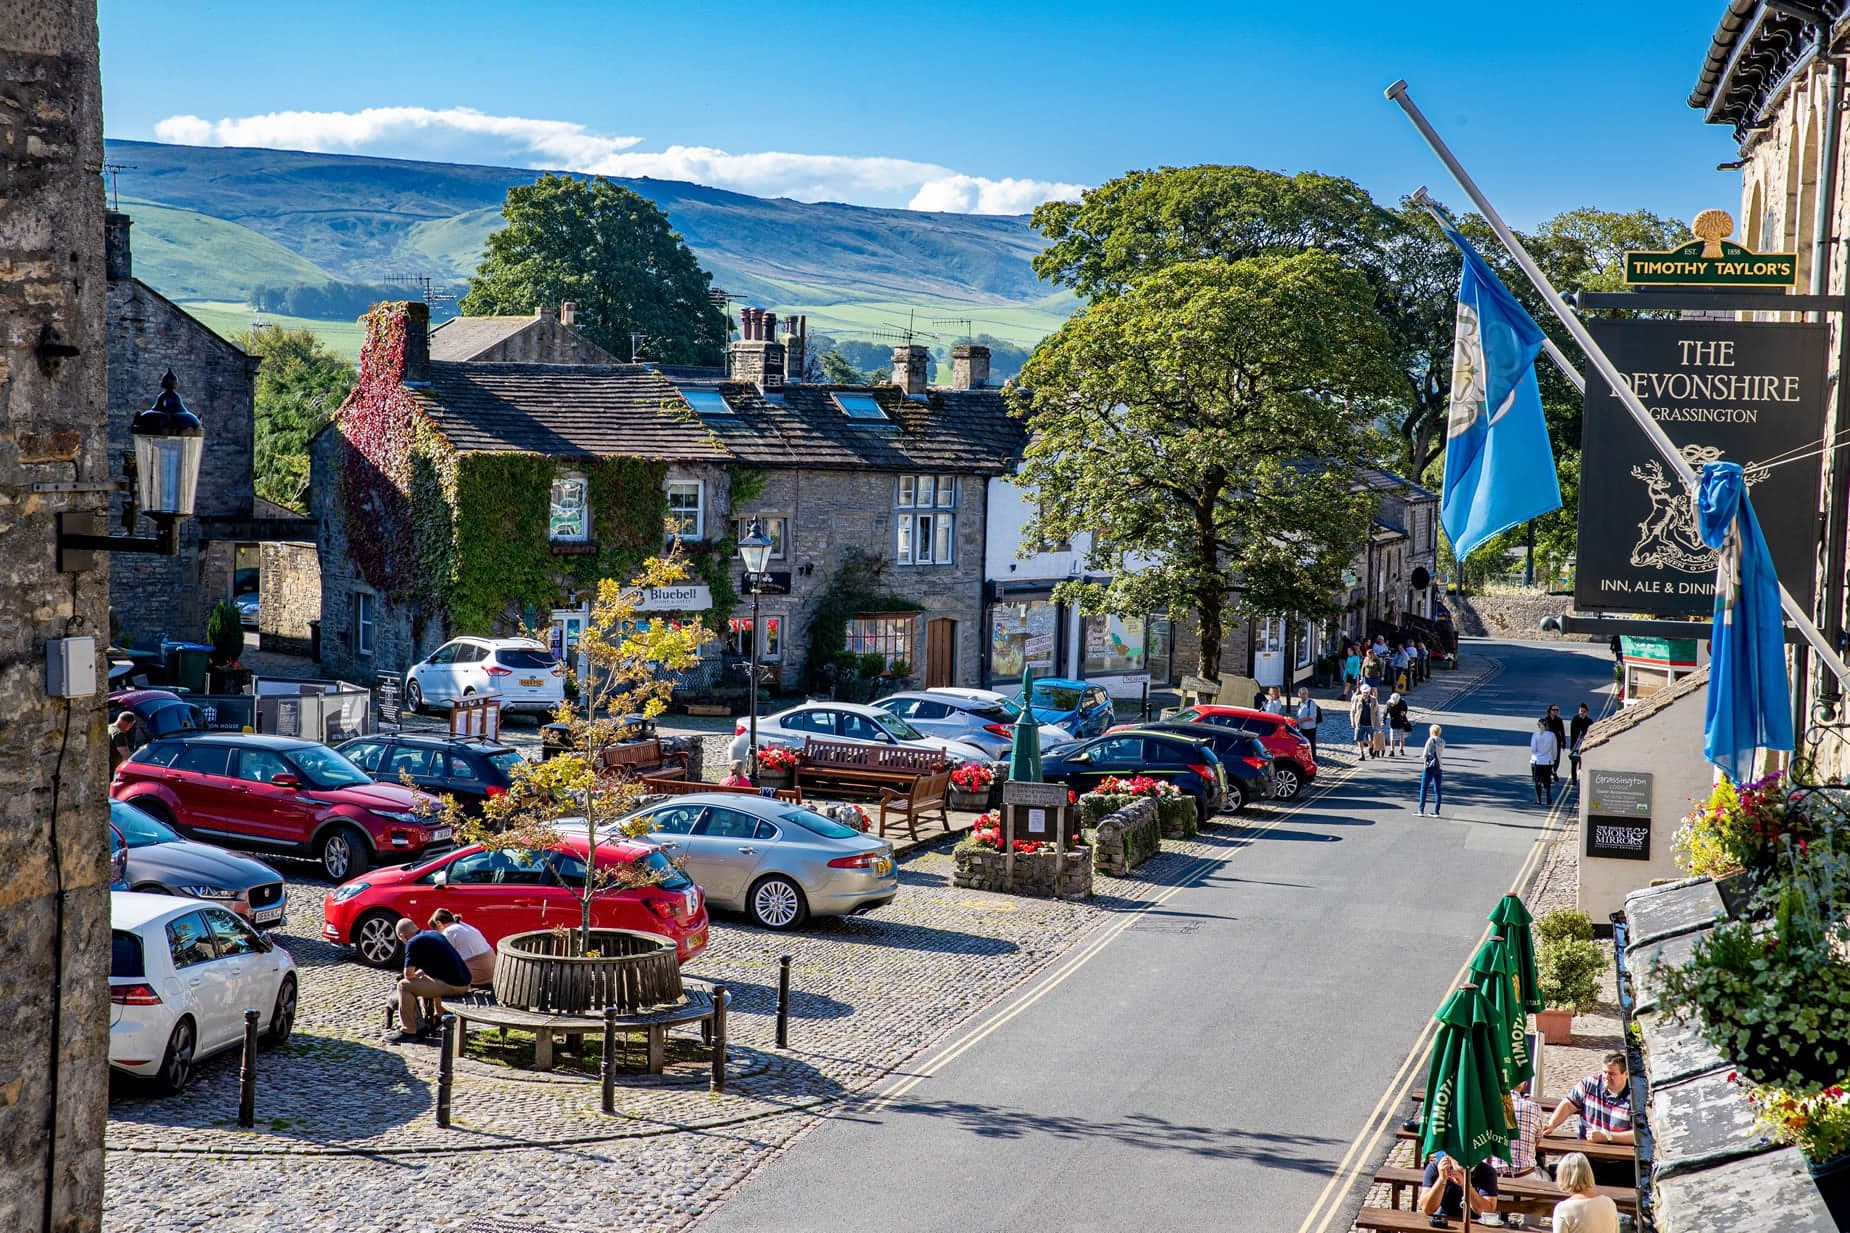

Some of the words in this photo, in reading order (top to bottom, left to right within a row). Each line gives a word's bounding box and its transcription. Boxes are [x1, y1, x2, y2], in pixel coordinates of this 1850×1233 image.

[1633, 261, 1708, 275] TIMOTHY
[1715, 262, 1790, 276] TAYLOR'S
[1678, 340, 1735, 367] THE
[1609, 372, 1800, 402] DEVONSHIRE
[1650, 407, 1758, 423] GRASSINGTON
[651, 589, 697, 600] Bluebell
[1601, 579, 1632, 592] INN,
[1634, 581, 1660, 593] ALE
[1664, 582, 1674, 593] &
[1678, 582, 1717, 595] DININ
[1595, 774, 1647, 787] Grassington
[1596, 828, 1632, 838] SMOKE
[1631, 827, 1648, 840] &
[1596, 836, 1642, 846] MIRRORS
